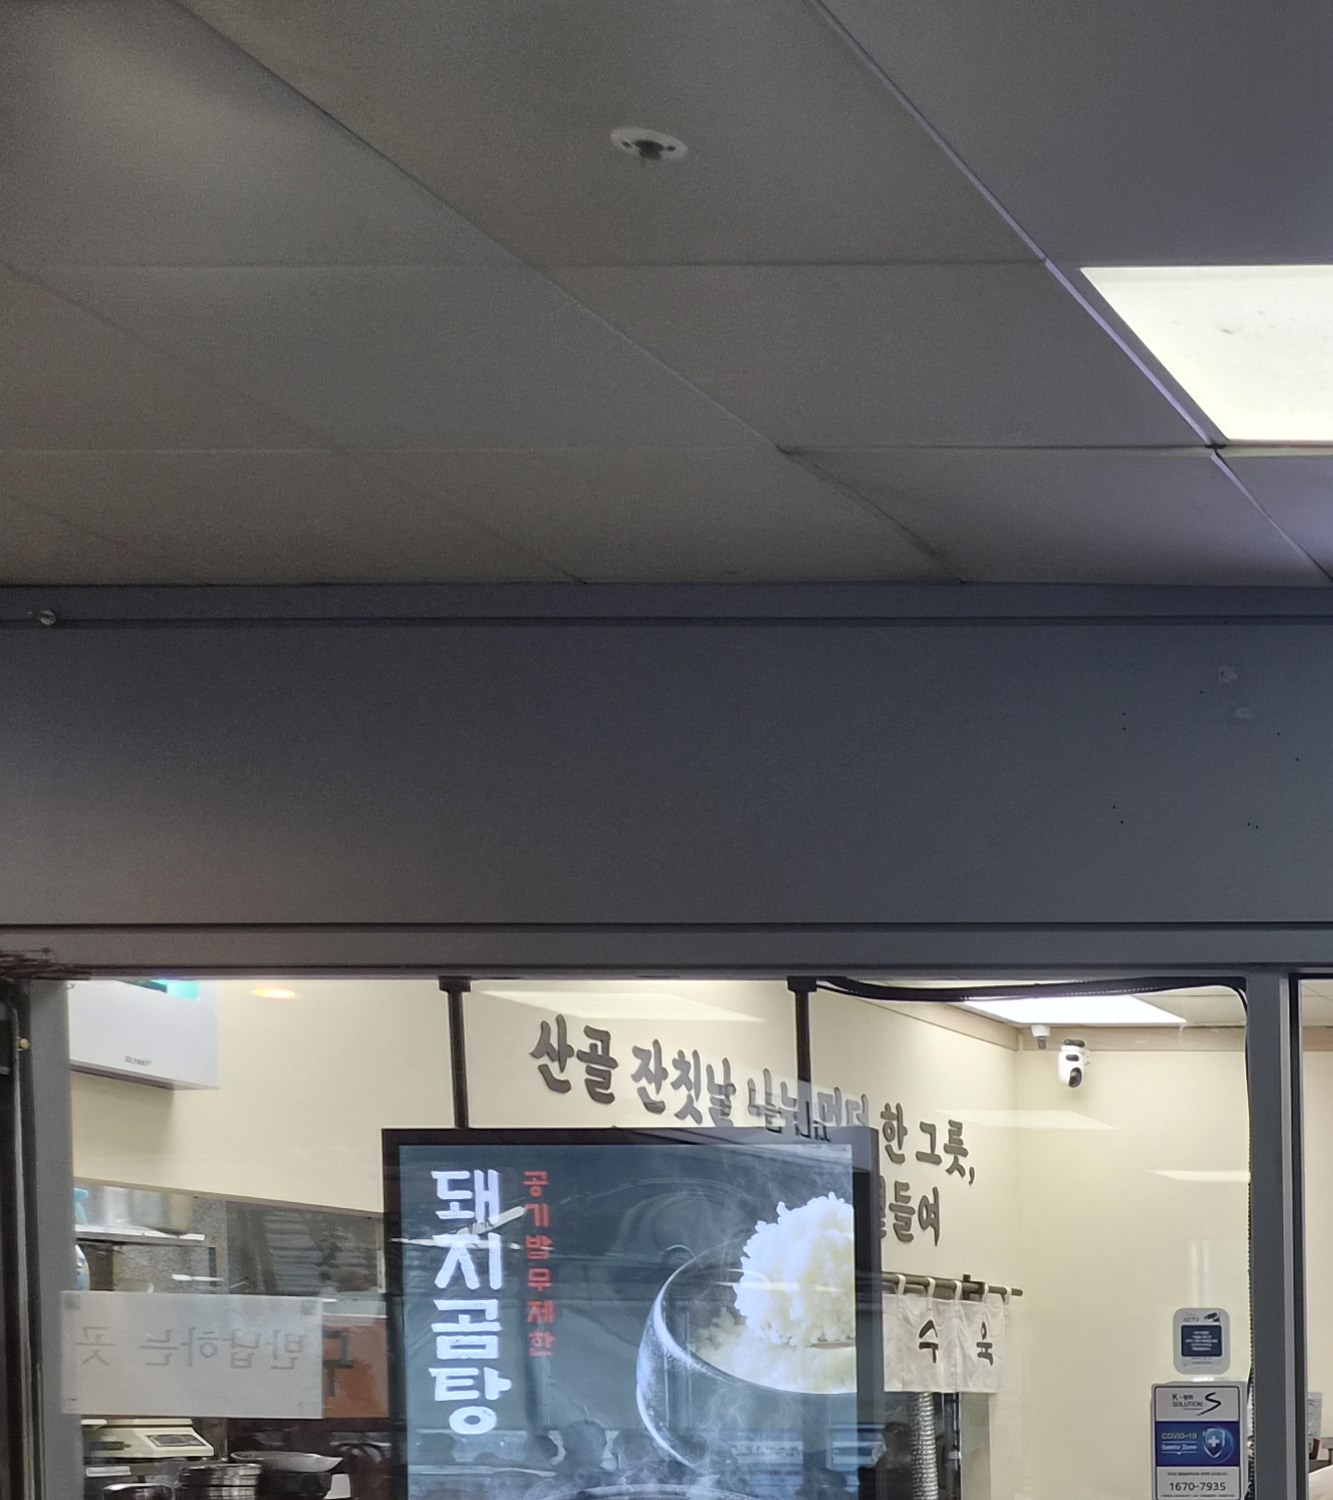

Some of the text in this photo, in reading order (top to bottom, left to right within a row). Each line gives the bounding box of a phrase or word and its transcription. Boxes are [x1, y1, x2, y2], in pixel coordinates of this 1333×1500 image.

[530, 1014, 619, 1105] 산골
[631, 1039, 737, 1128] 잔칫날
[880, 1102, 908, 1165] 한
[915, 1119, 976, 1185] 그릇,
[879, 1174, 940, 1247] 들여
[428, 1168, 512, 1435] 돼지곰탕
[1169, 1481, 1226, 1491] 1670-7935
